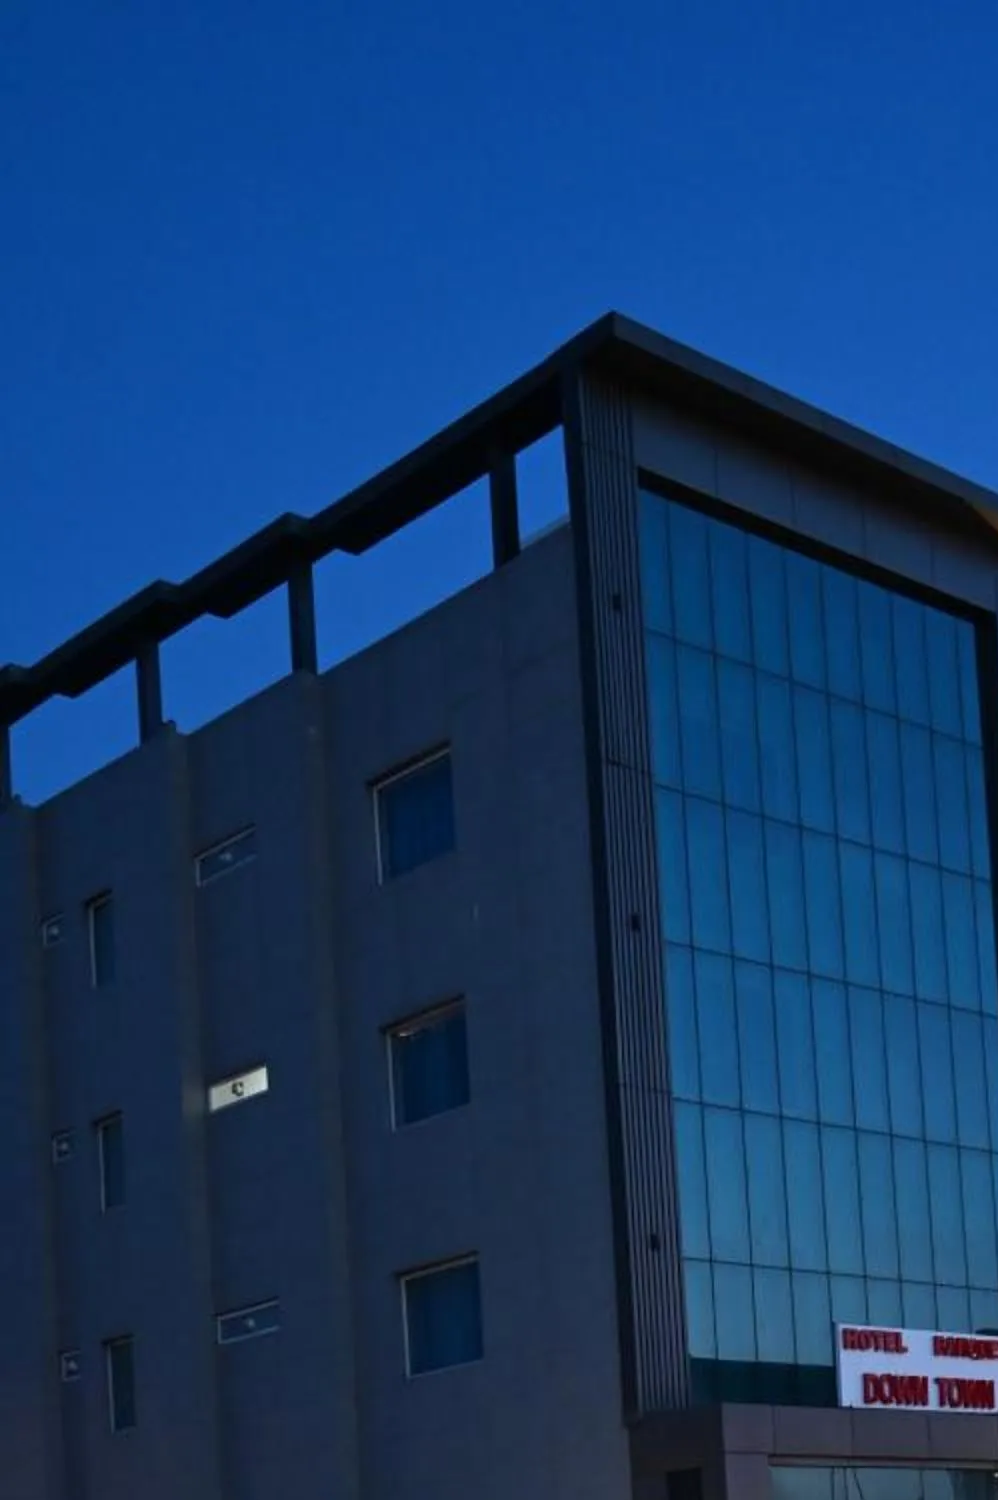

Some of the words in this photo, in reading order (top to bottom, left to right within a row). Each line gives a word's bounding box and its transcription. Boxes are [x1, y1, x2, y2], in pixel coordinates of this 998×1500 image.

[842, 1328, 908, 1353] HOTEL
[863, 1372, 929, 1407] DOWN
[935, 1377, 996, 1410] TOWN
